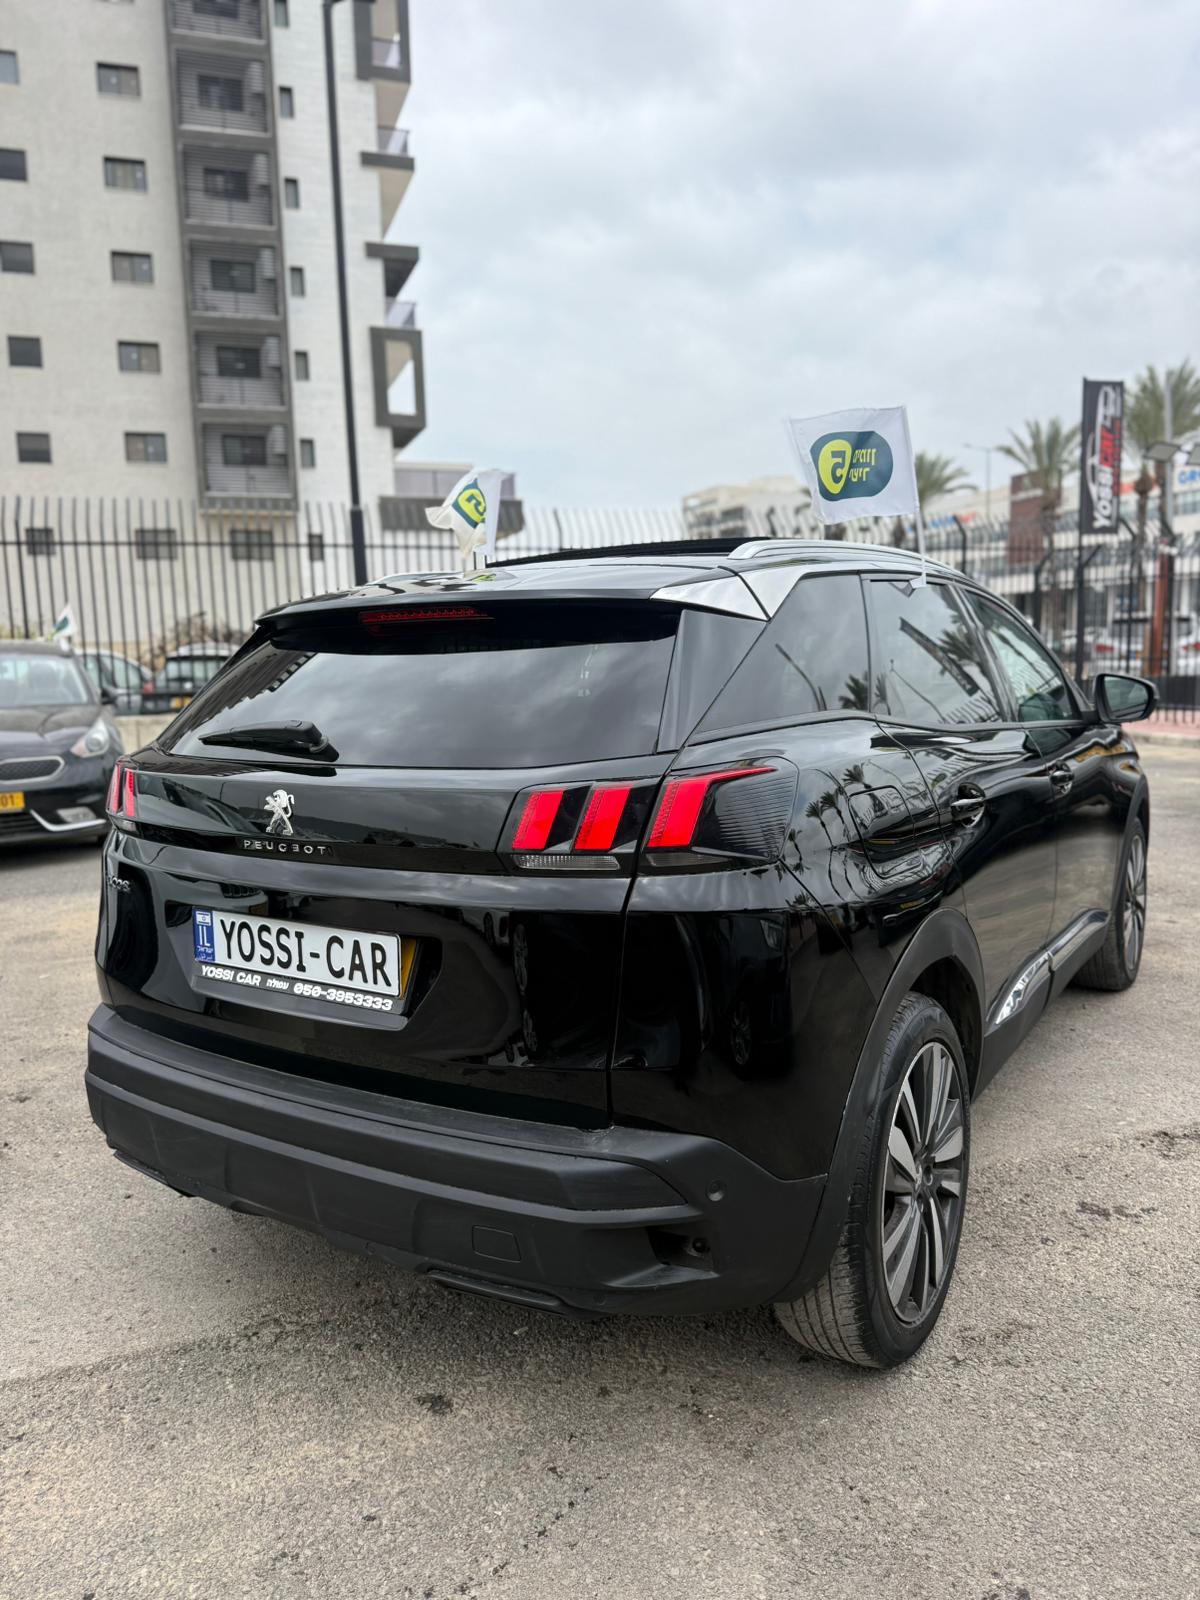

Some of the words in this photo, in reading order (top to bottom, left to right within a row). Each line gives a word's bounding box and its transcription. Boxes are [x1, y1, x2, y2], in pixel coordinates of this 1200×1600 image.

[243, 840, 326, 855] PEUGEOT
[198, 925, 211, 947] IL
[220, 918, 392, 987] YOSSI-CAR
[201, 965, 234, 981] YOSSI
[236, 971, 261, 987] CAR
[293, 982, 394, 1011] 050-3953333
